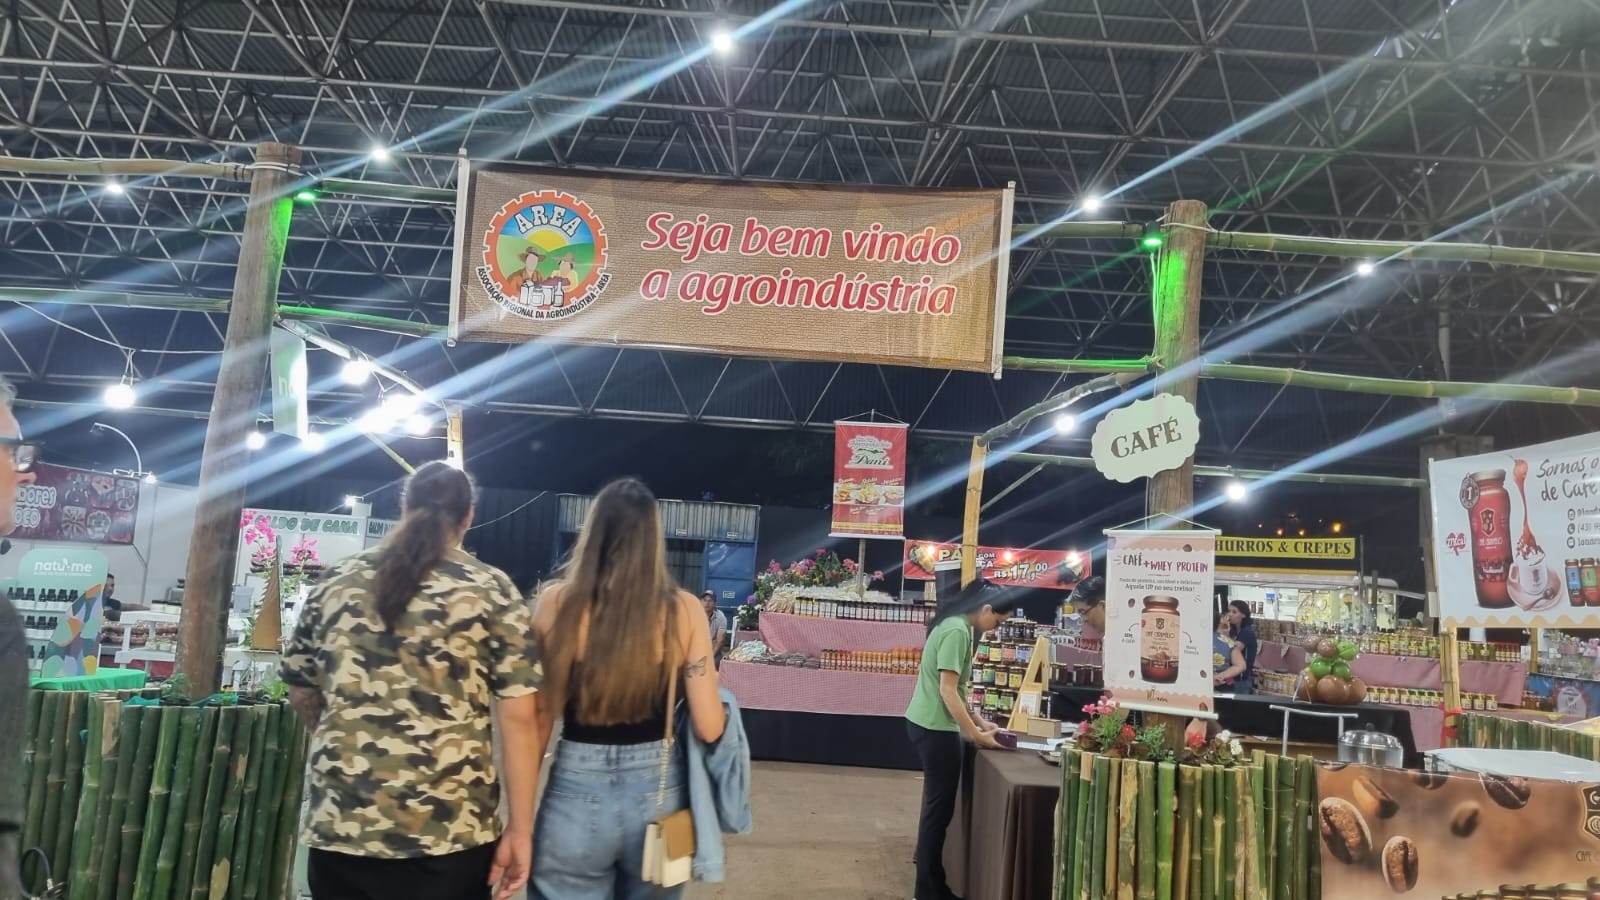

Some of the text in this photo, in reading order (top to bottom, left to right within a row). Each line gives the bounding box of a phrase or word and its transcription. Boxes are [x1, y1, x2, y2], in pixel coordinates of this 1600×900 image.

[514, 205, 581, 237] AREA
[641, 212, 960, 265] Seja bem vindo
[535, 311, 545, 319] DA
[598, 274, 611, 293] AREA
[641, 267, 956, 314] a agroindústria
[1111, 416, 1181, 458] CAFÉ
[1536, 457, 1586, 478] Somos
[1541, 480, 1559, 501] de
[1123, 552, 1142, 566] CAFÉ
[1177, 562, 1208, 572] PROTEIN
[1215, 540, 1351, 554] HURROS & CREPES
